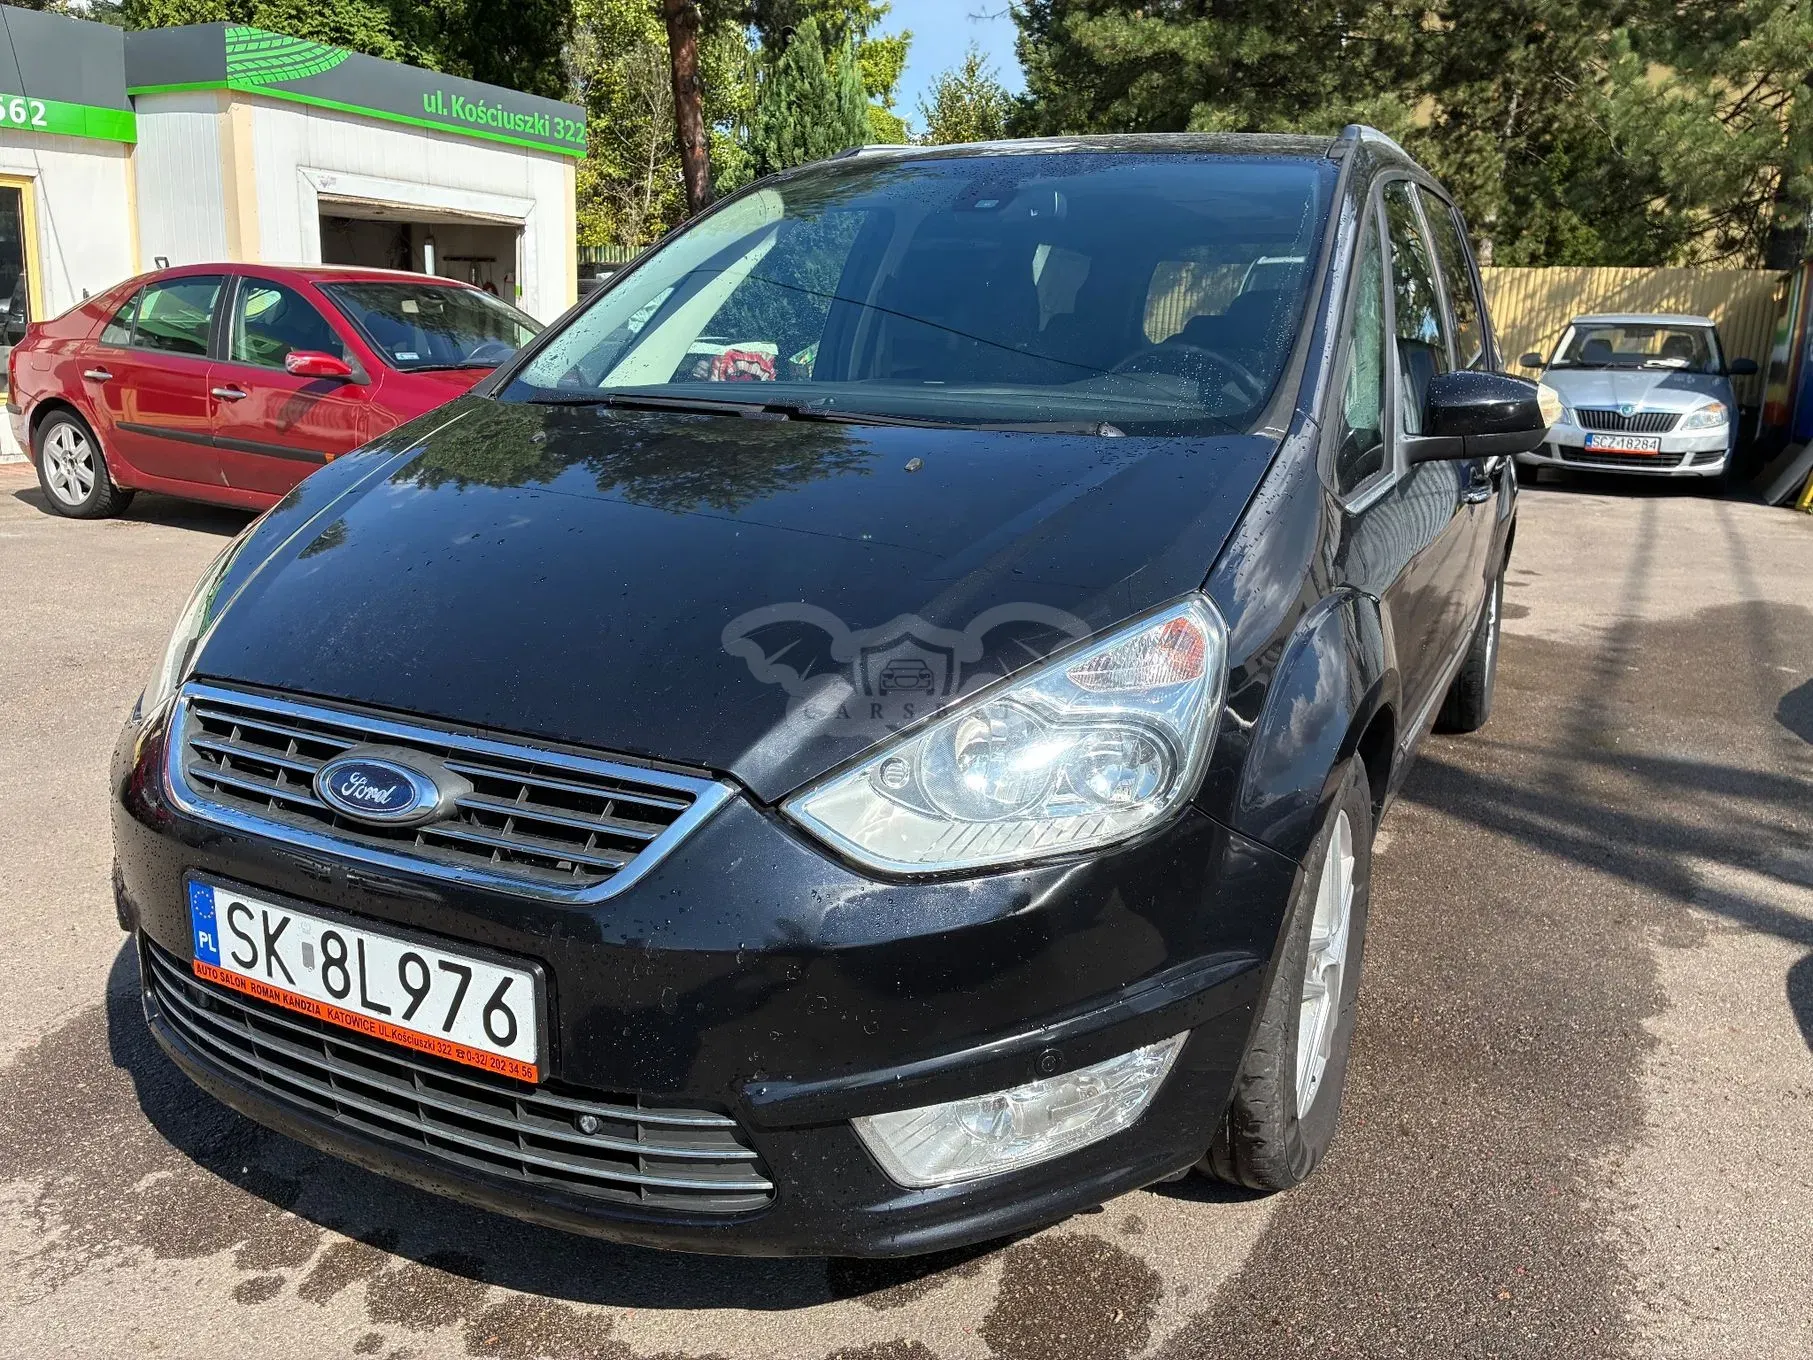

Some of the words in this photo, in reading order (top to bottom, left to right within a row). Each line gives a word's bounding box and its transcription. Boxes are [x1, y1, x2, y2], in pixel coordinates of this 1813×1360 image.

[423, 90, 447, 115] ul.
[451, 94, 550, 137] Kościuszki
[554, 117, 586, 144] 322
[1620, 438, 1657, 450] 18284
[341, 772, 396, 804] Ford
[198, 930, 217, 953] PL
[227, 902, 296, 986] SK
[320, 930, 518, 1048] 8L976
[196, 963, 218, 979] AUTO
[219, 973, 247, 989] SALON
[250, 985, 280, 1000] ROMAN
[282, 994, 321, 1016] KANDZIA
[327, 1008, 376, 1032] KATOWICE
[438, 1043, 452, 1056] 322
[490, 1058, 506, 1071] 202
[508, 1063, 520, 1076] 34
[521, 1066, 533, 1079] 56
